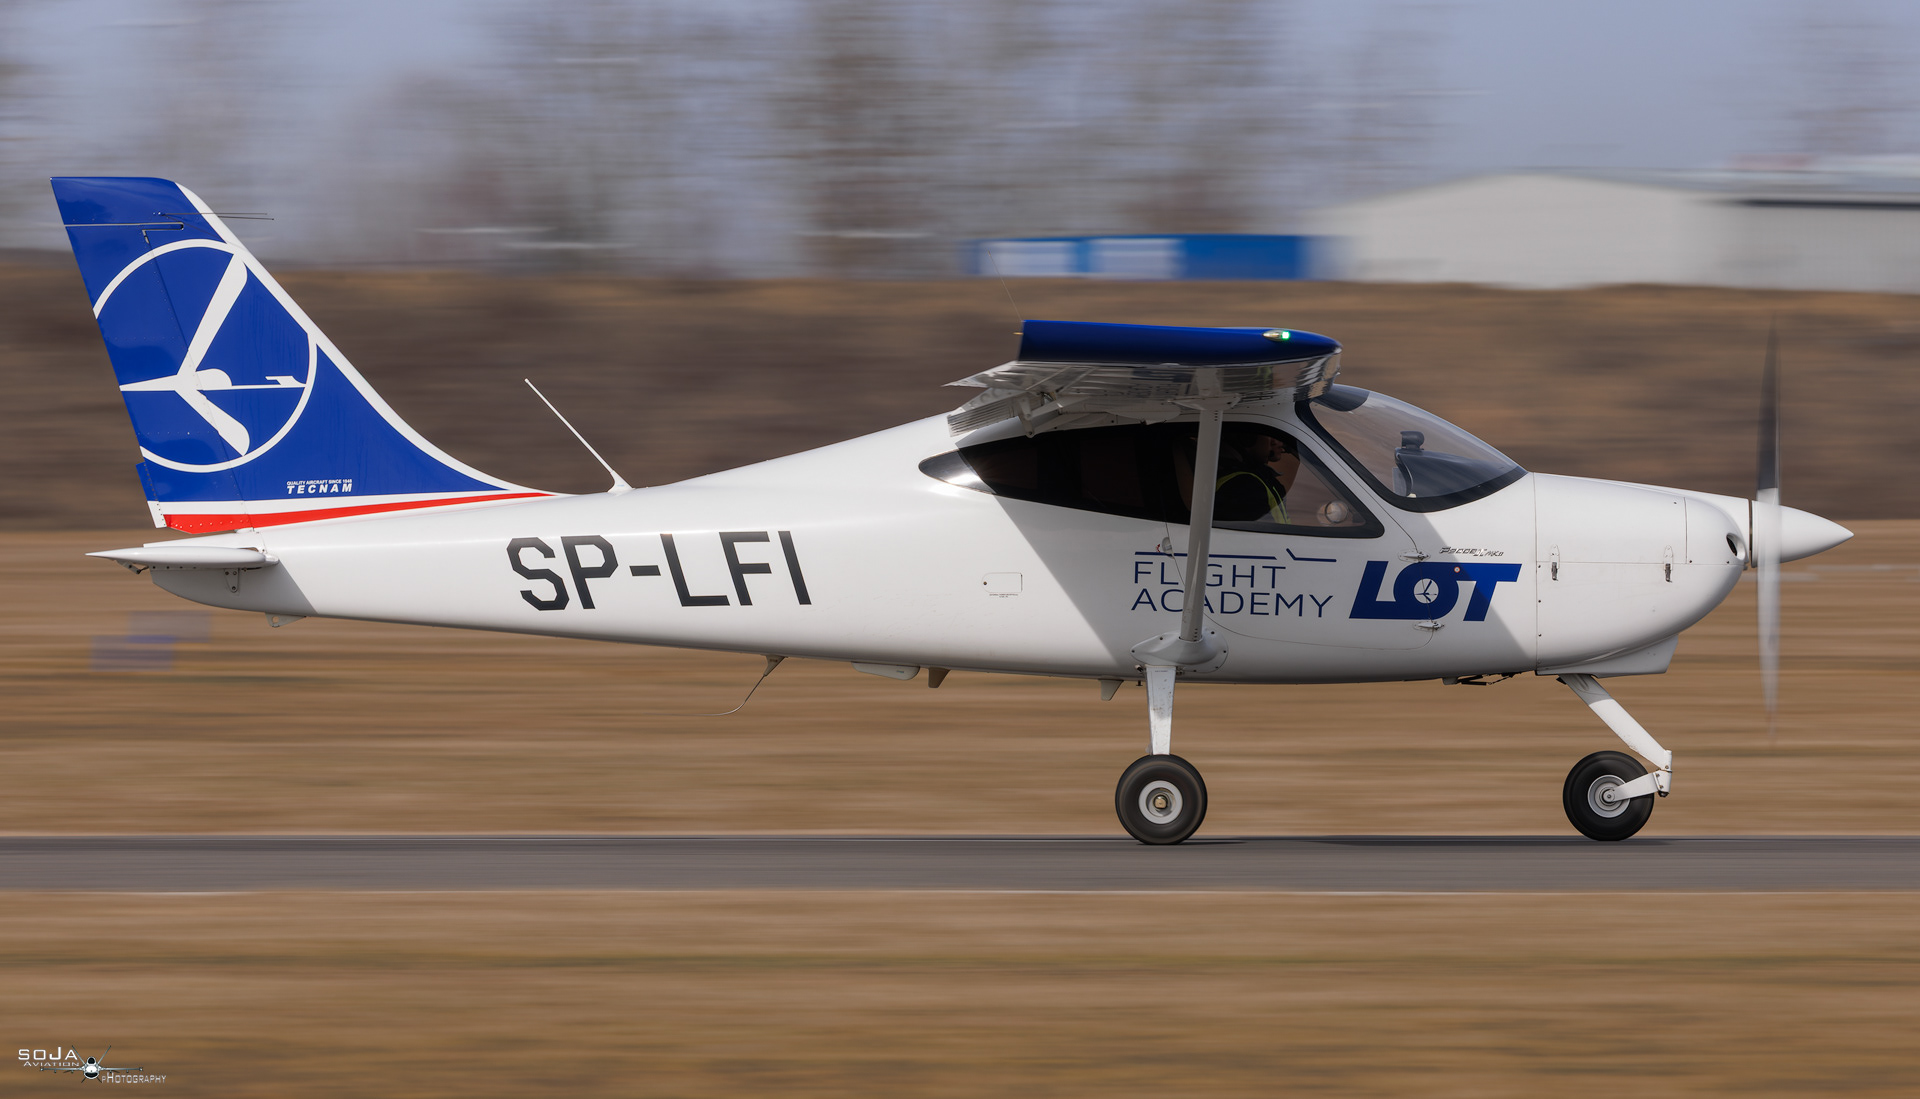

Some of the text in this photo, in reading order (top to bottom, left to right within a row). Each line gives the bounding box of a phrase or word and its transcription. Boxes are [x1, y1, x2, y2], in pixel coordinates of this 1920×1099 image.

[286, 483, 353, 495] TECNAM
[506, 530, 812, 611] SP-LFI
[1134, 561, 1286, 589] FLGHT
[1349, 560, 1523, 622] LOT
